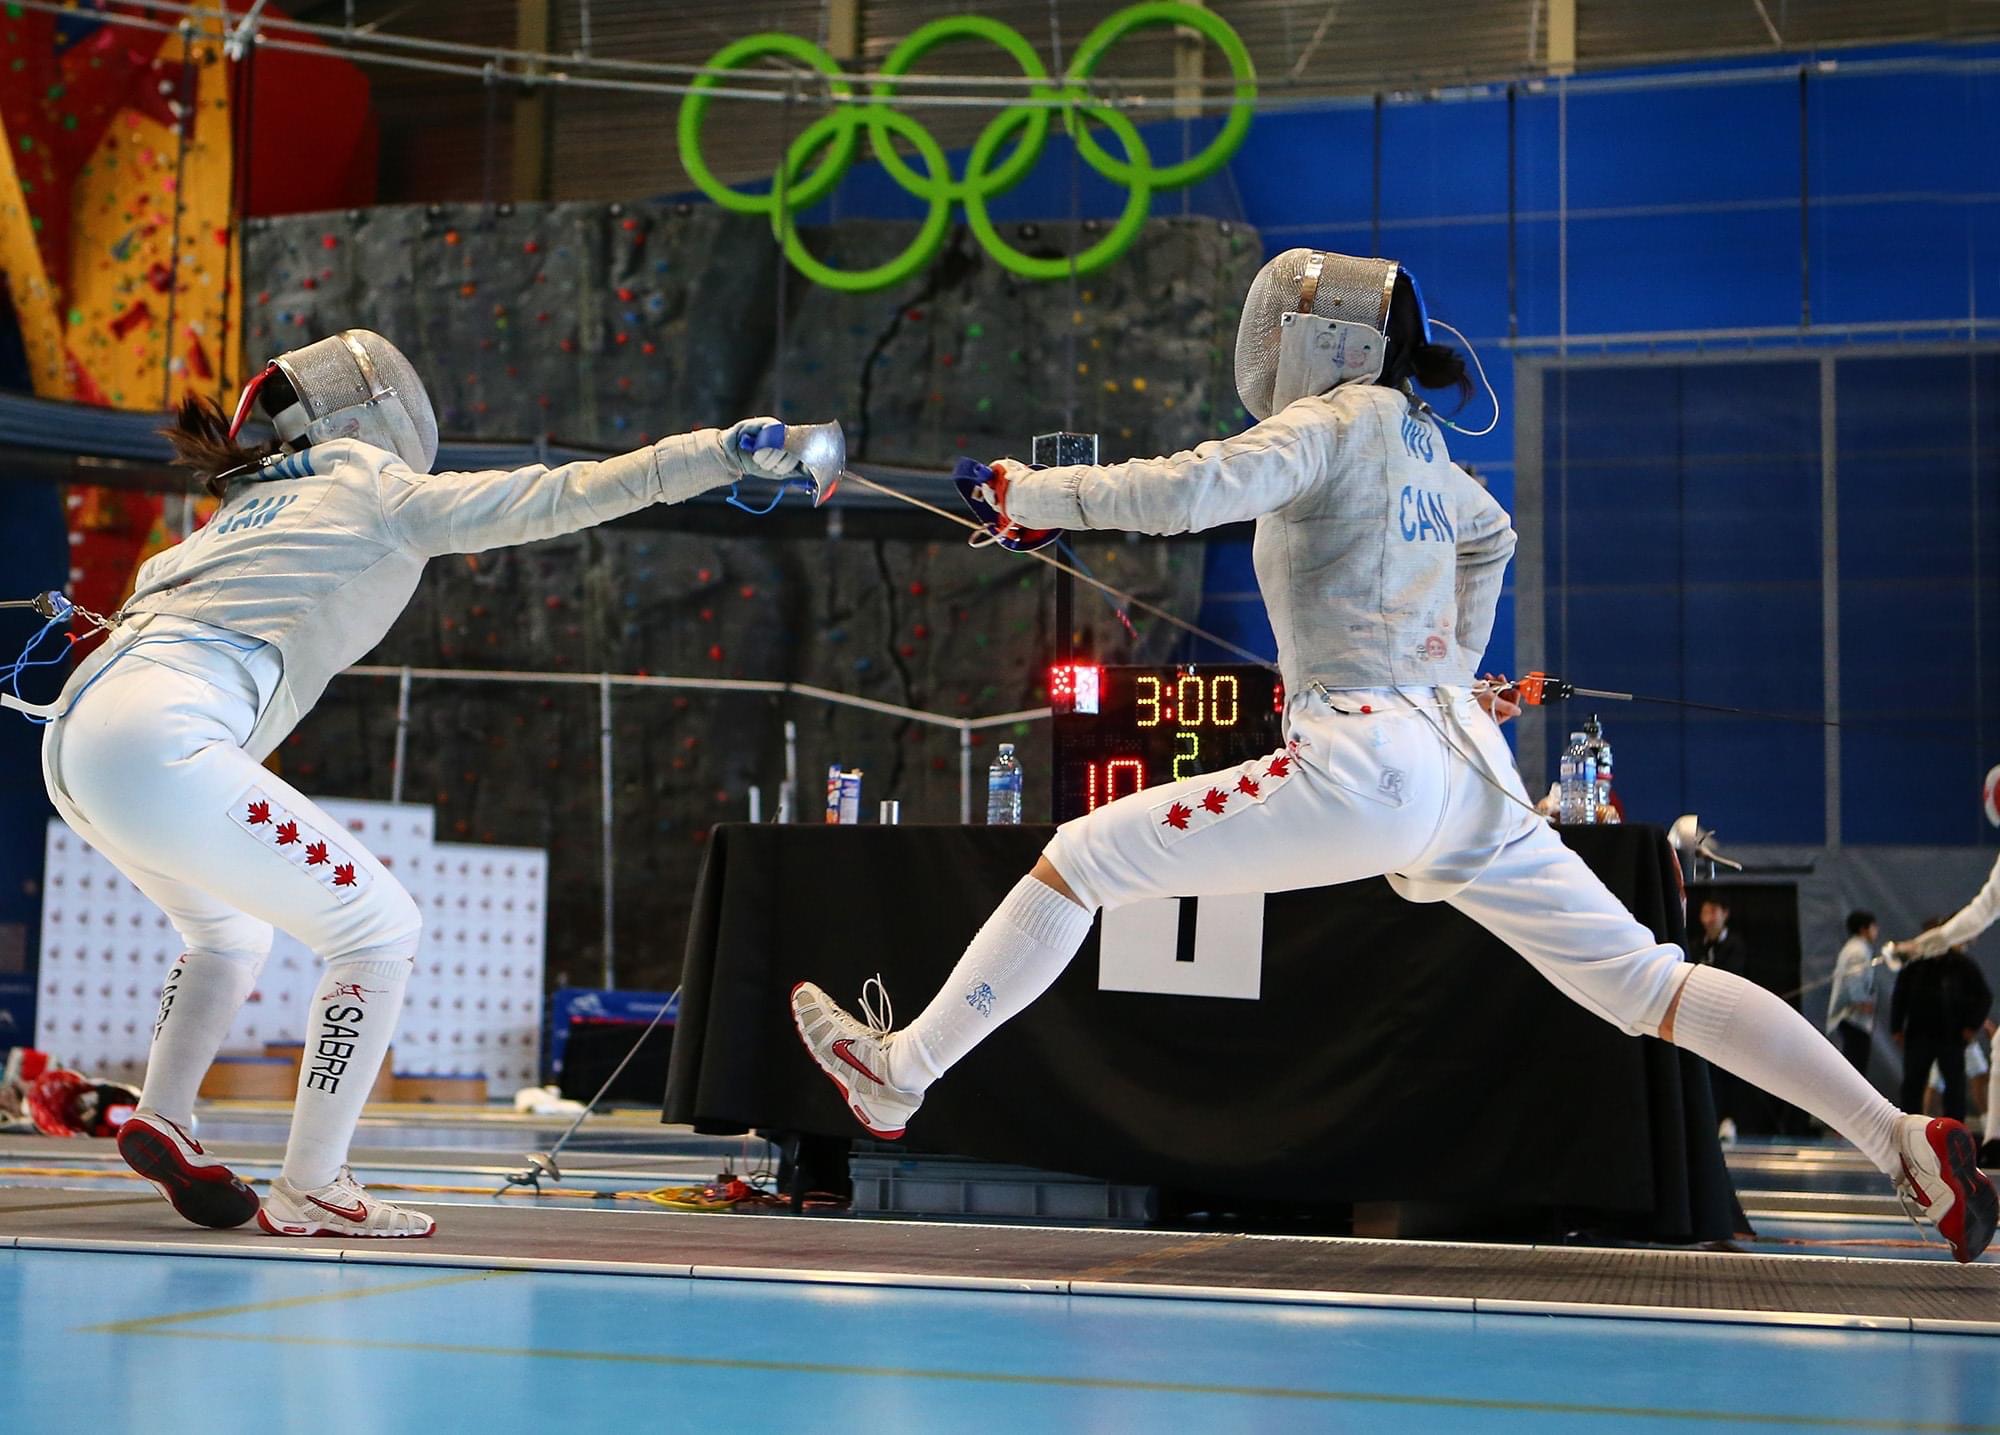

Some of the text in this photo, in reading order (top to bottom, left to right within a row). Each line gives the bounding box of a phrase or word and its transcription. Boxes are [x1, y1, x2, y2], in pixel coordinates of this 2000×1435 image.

[1400, 485, 1455, 544] CAN
[1136, 675, 1239, 727] 3:00
[1172, 731, 1200, 783] 2
[306, 1004, 364, 1094] SABRE
